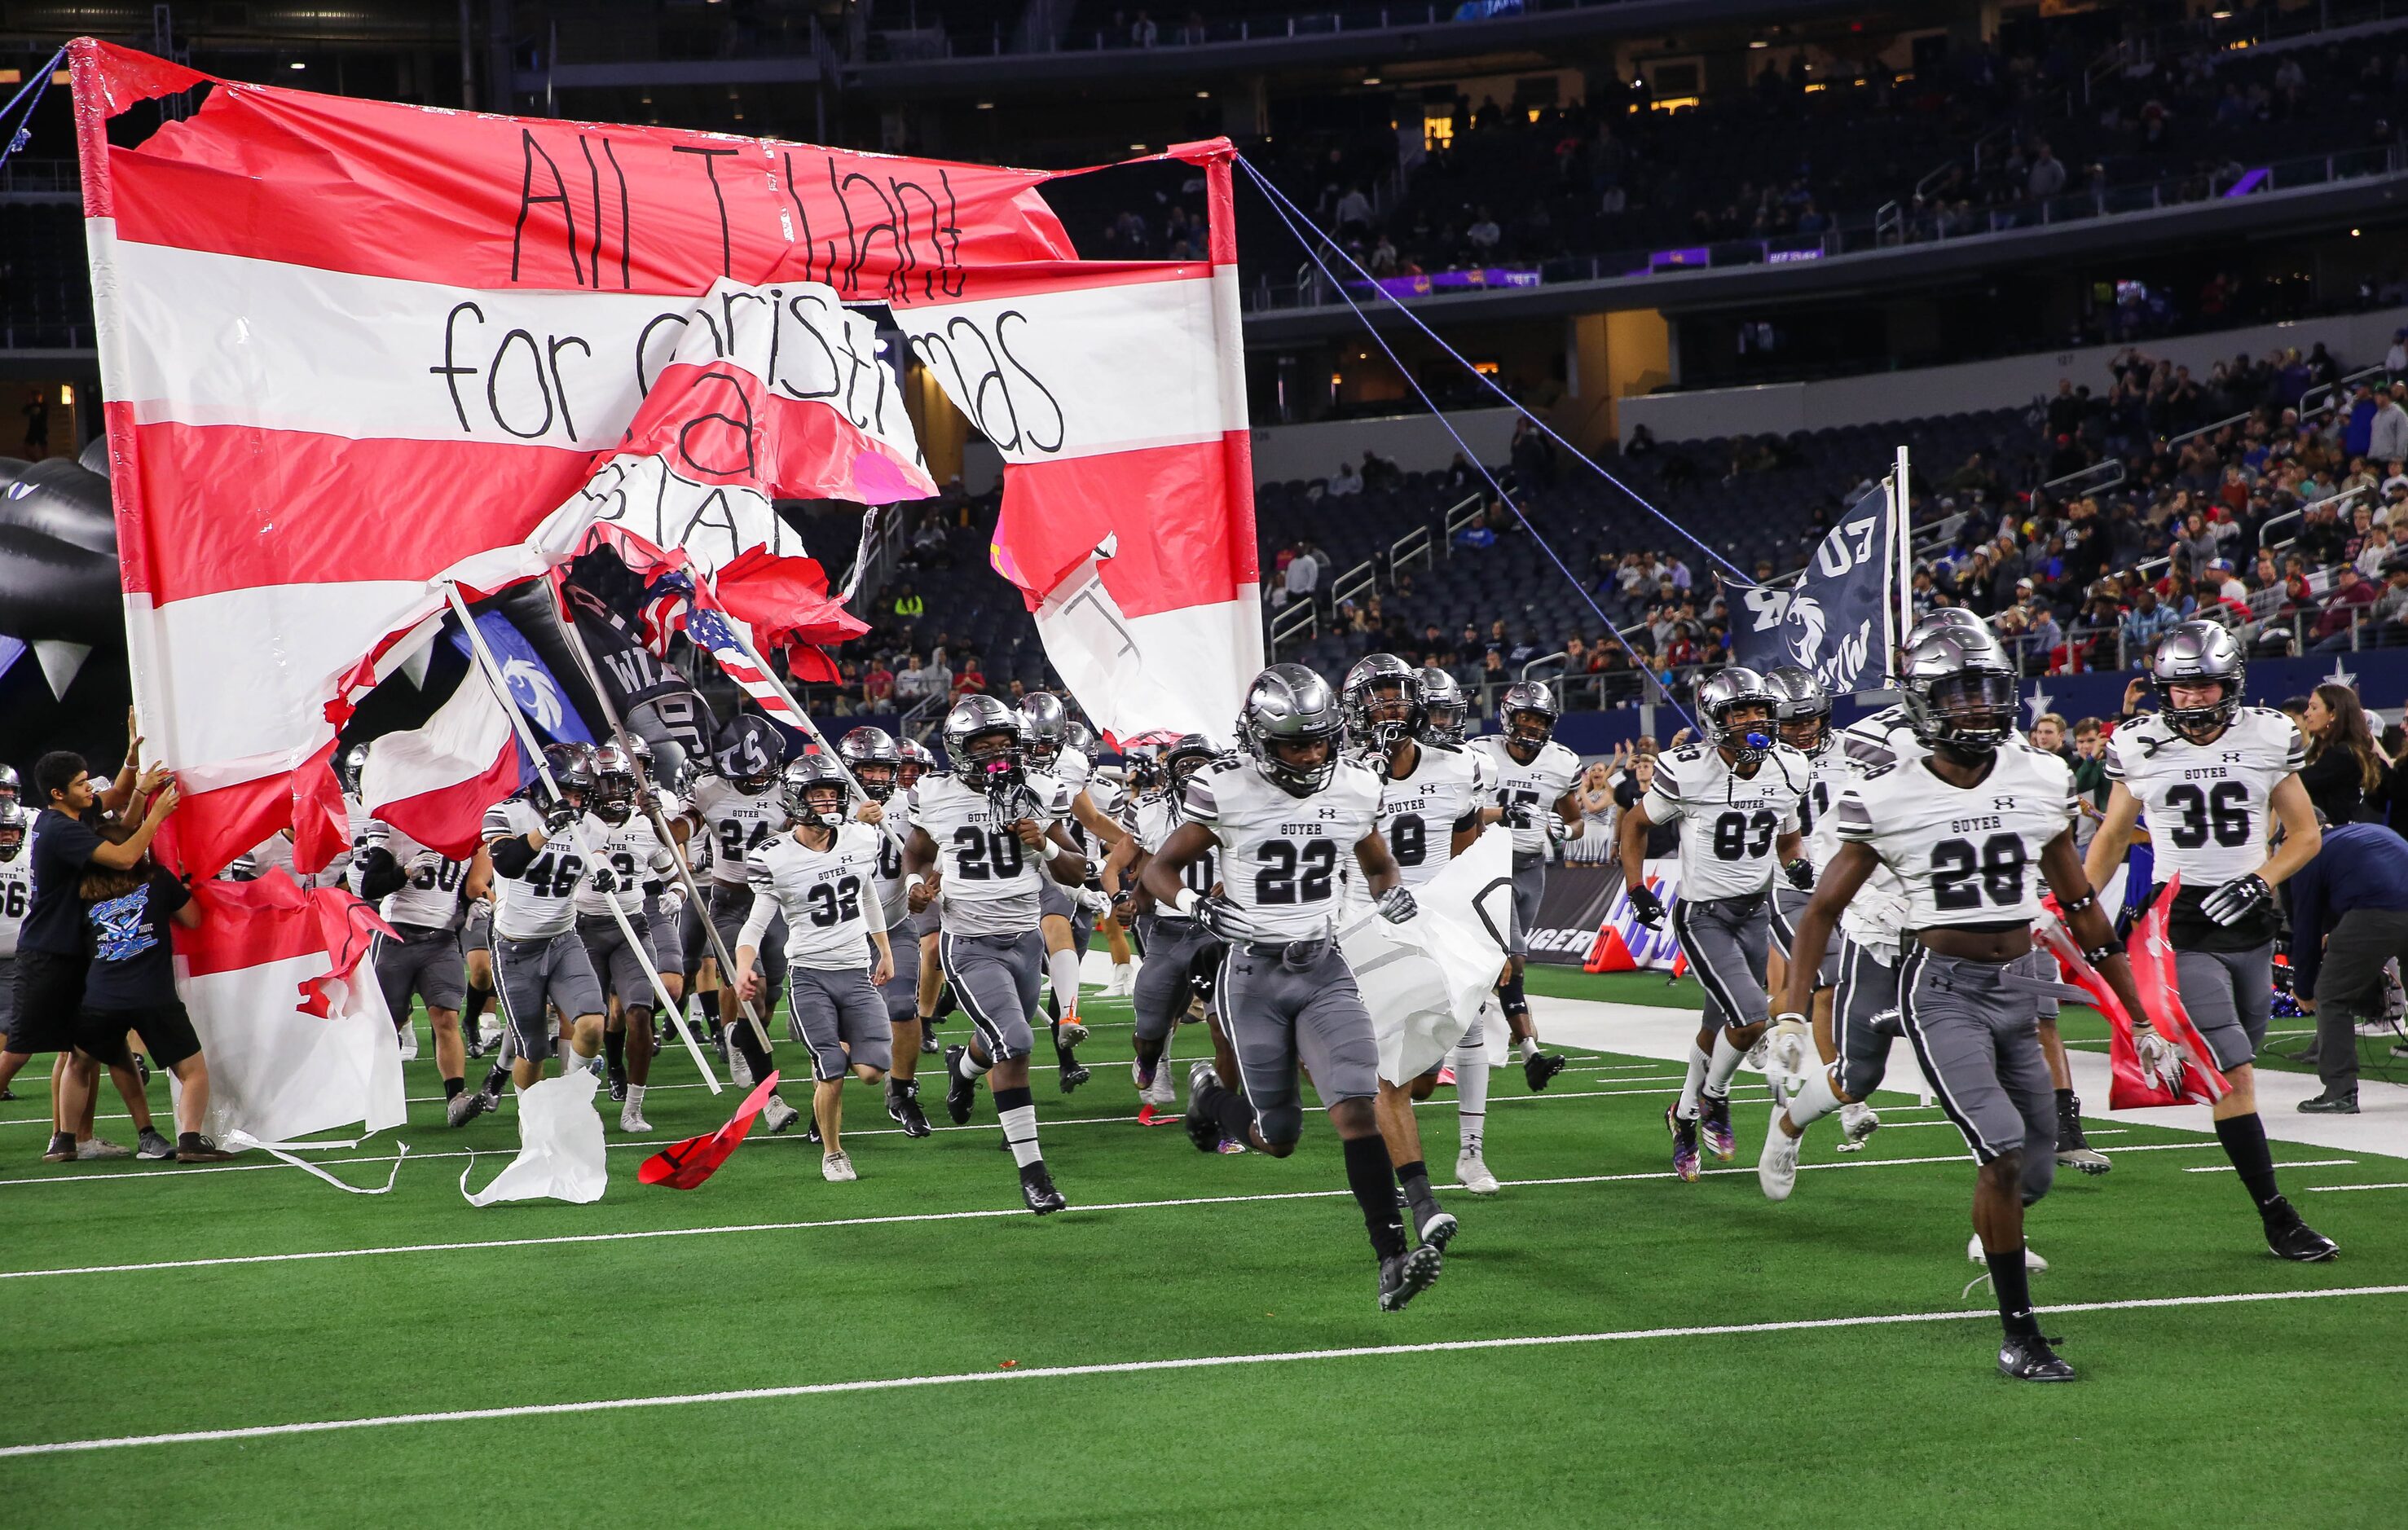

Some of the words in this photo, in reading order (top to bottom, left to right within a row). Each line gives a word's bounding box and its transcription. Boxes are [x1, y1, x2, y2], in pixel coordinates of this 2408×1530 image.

[512, 128, 630, 290] All
[429, 301, 592, 442] for
[1507, 779, 1534, 790] GUYER
[2186, 767, 2228, 780] GUYER
[732, 809, 760, 819] GUYER
[966, 813, 1001, 824] GUY
[1388, 798, 1427, 814] GUYER
[1733, 800, 1765, 810] GUYER
[1952, 816, 2002, 833] GUYER
[2165, 780, 2251, 850] 36
[718, 818, 769, 863] 24
[953, 825, 1024, 880] 20
[1280, 823, 1323, 836] GUYER
[1390, 812, 1428, 867] 8
[1713, 810, 1780, 862] 83
[525, 851, 583, 899] 46
[817, 866, 848, 882] GUYER
[1256, 838, 1338, 905] 22
[1930, 832, 2028, 912] 28
[807, 874, 861, 928] 32
